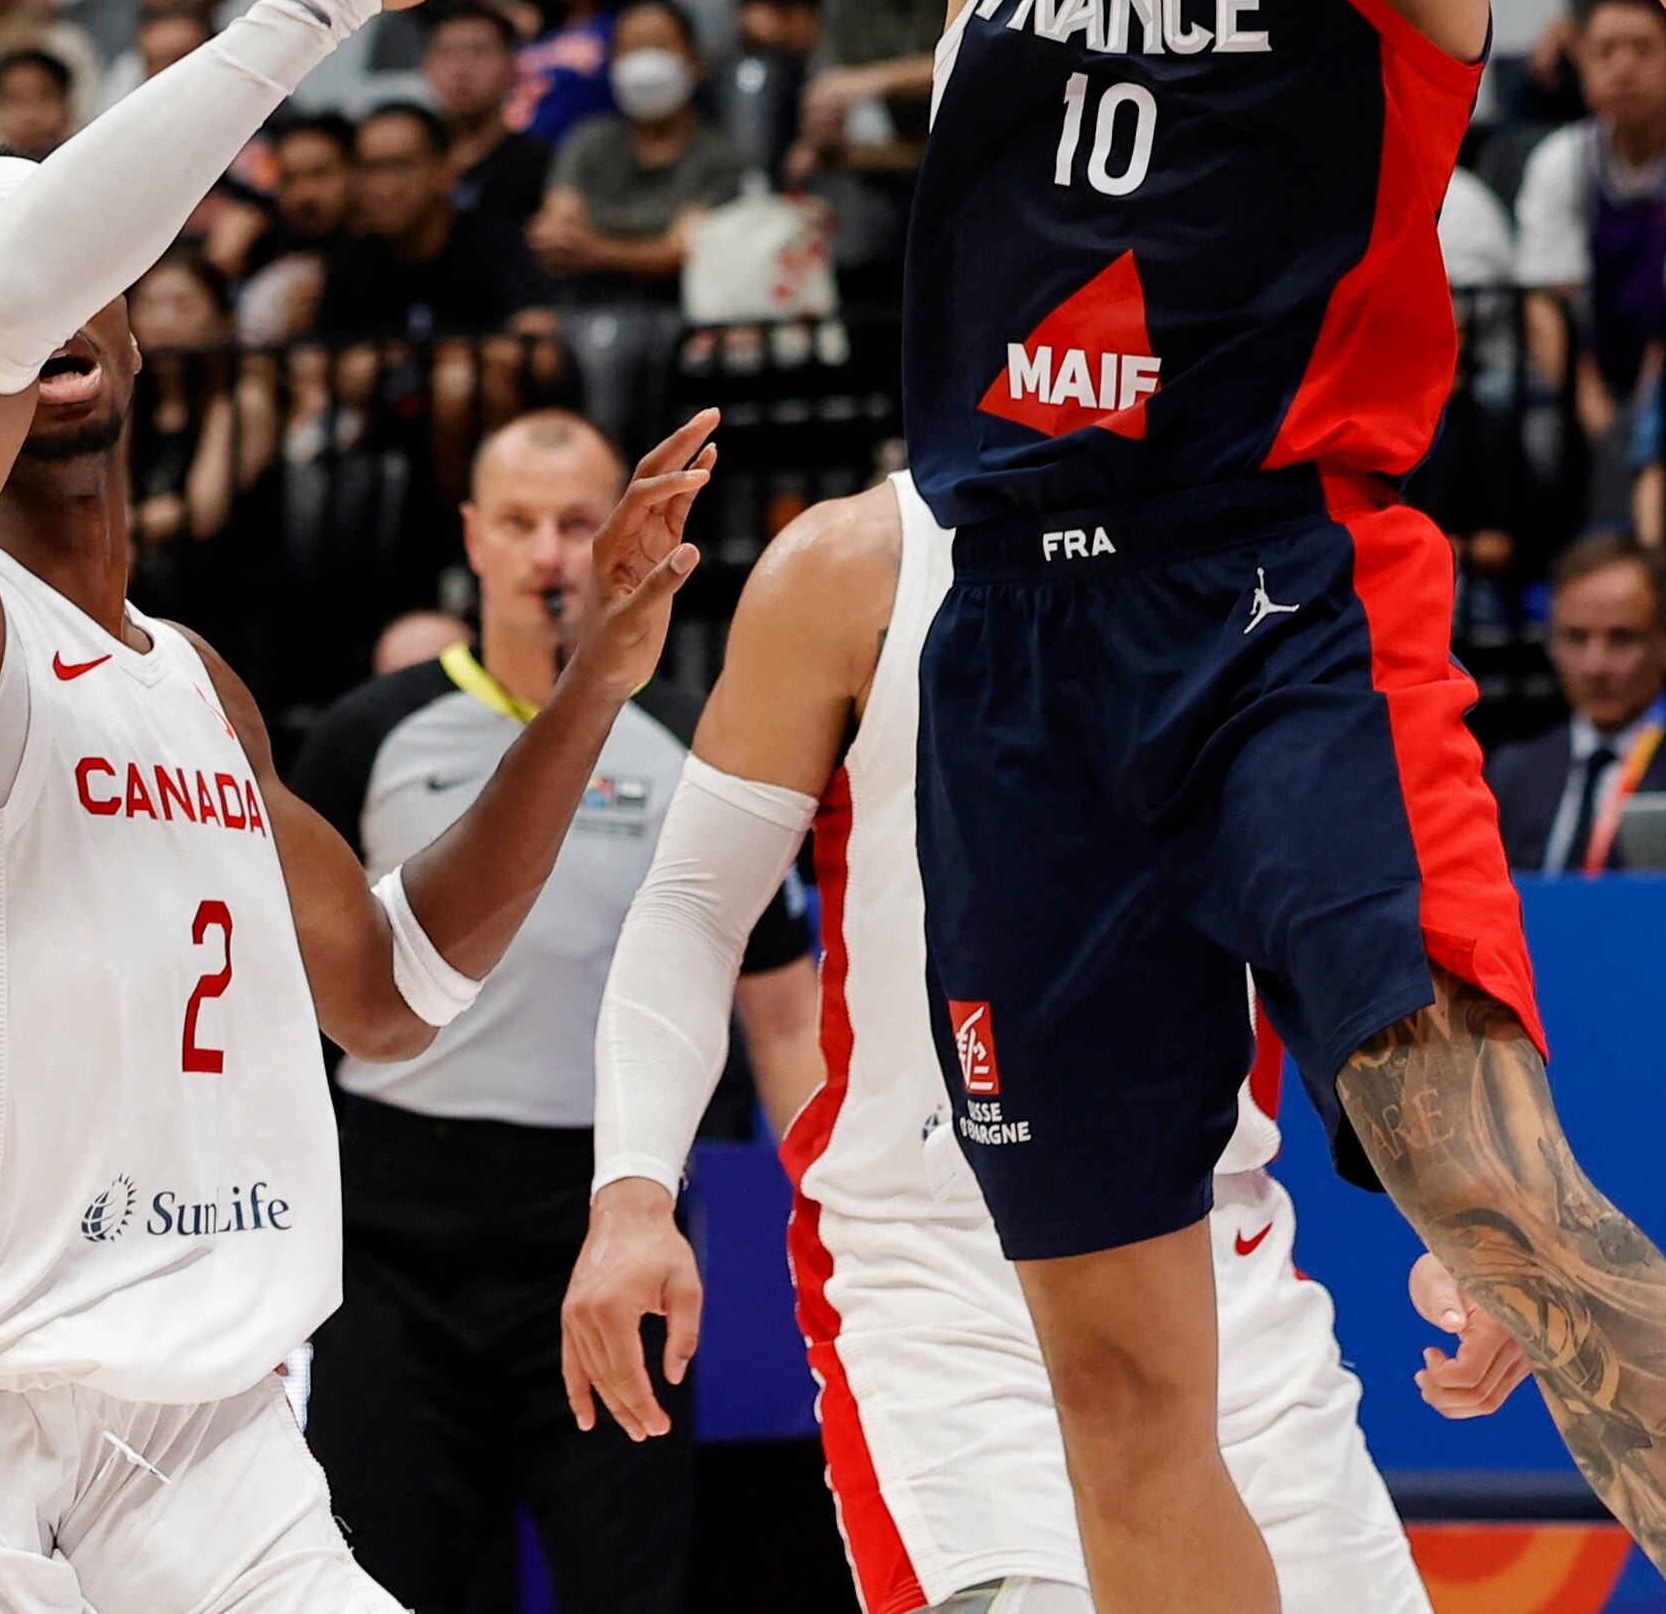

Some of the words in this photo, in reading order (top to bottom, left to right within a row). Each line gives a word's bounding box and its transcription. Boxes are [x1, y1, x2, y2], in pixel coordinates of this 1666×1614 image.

[1054, 72, 1158, 197] 10
[1007, 342, 1162, 412] MAIF
[1042, 526, 1117, 562] FRA
[75, 757, 268, 838] CANADA
[182, 899, 234, 1074] 2
